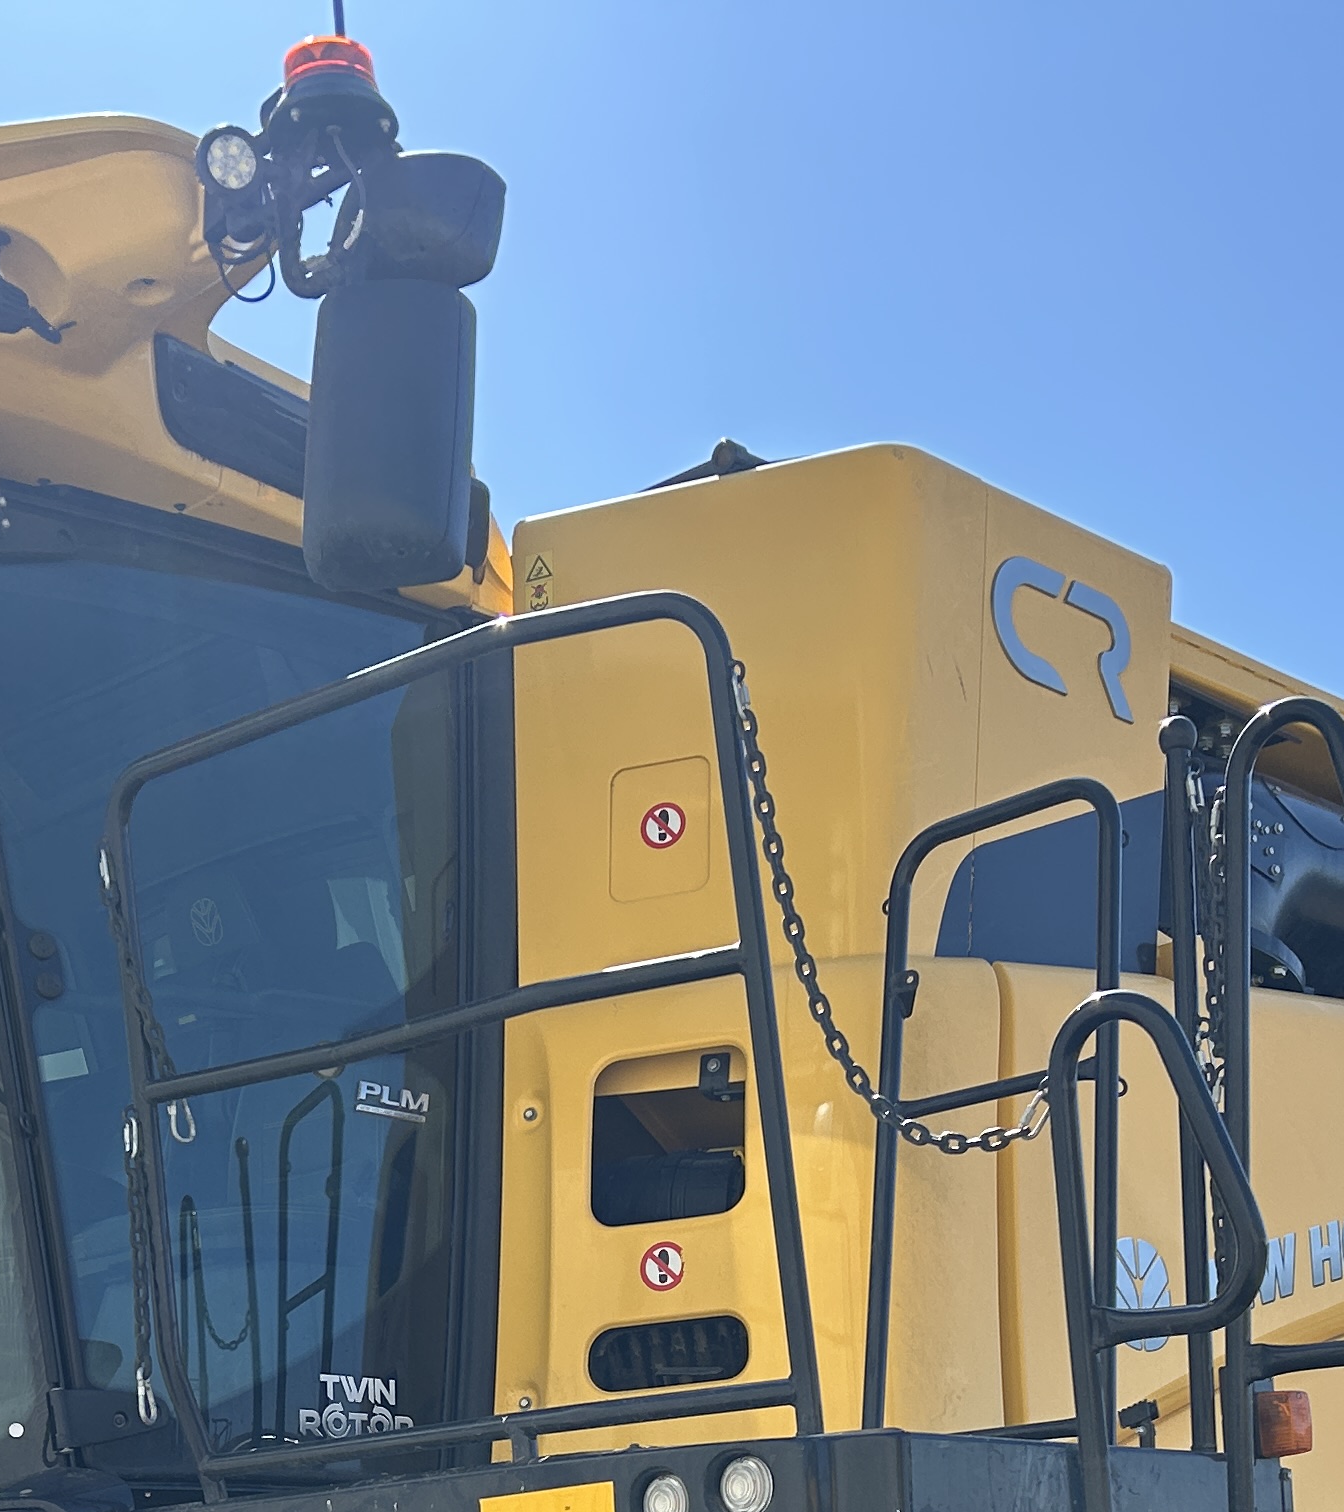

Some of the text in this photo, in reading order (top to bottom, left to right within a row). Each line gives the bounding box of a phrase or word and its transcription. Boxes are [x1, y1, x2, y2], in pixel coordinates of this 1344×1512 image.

[990, 555, 1134, 726] CR
[357, 1080, 430, 1113] PLM
[319, 1373, 396, 1406] TWIN
